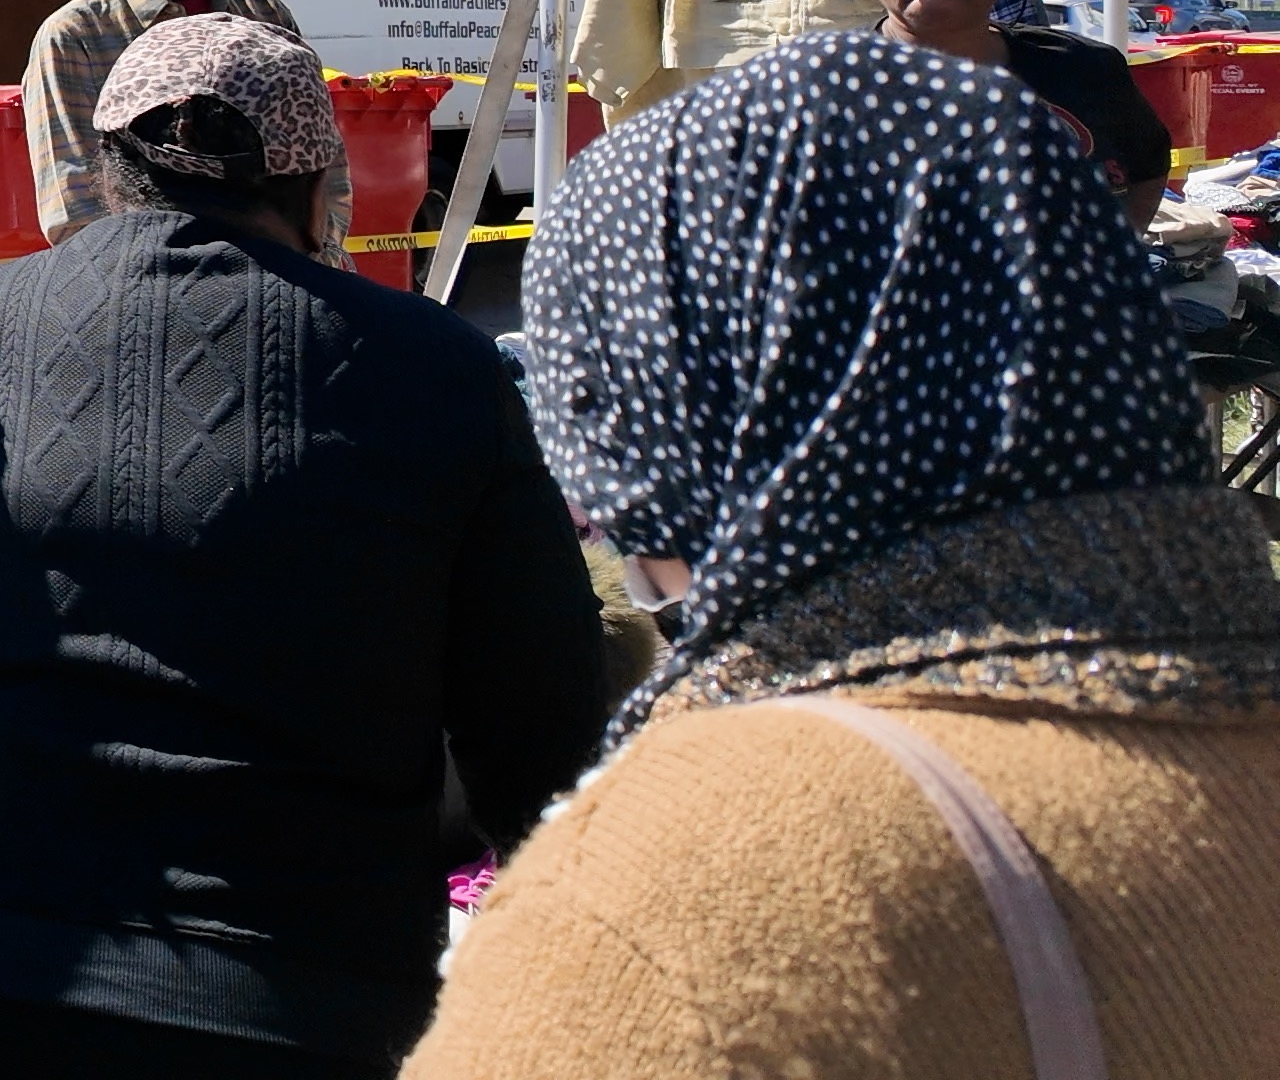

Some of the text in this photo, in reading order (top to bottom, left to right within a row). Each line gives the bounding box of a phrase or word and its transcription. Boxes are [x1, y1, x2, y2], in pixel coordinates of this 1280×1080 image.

[402, 56, 490, 74] Back To Basic
[470, 230, 508, 243] AUTION
